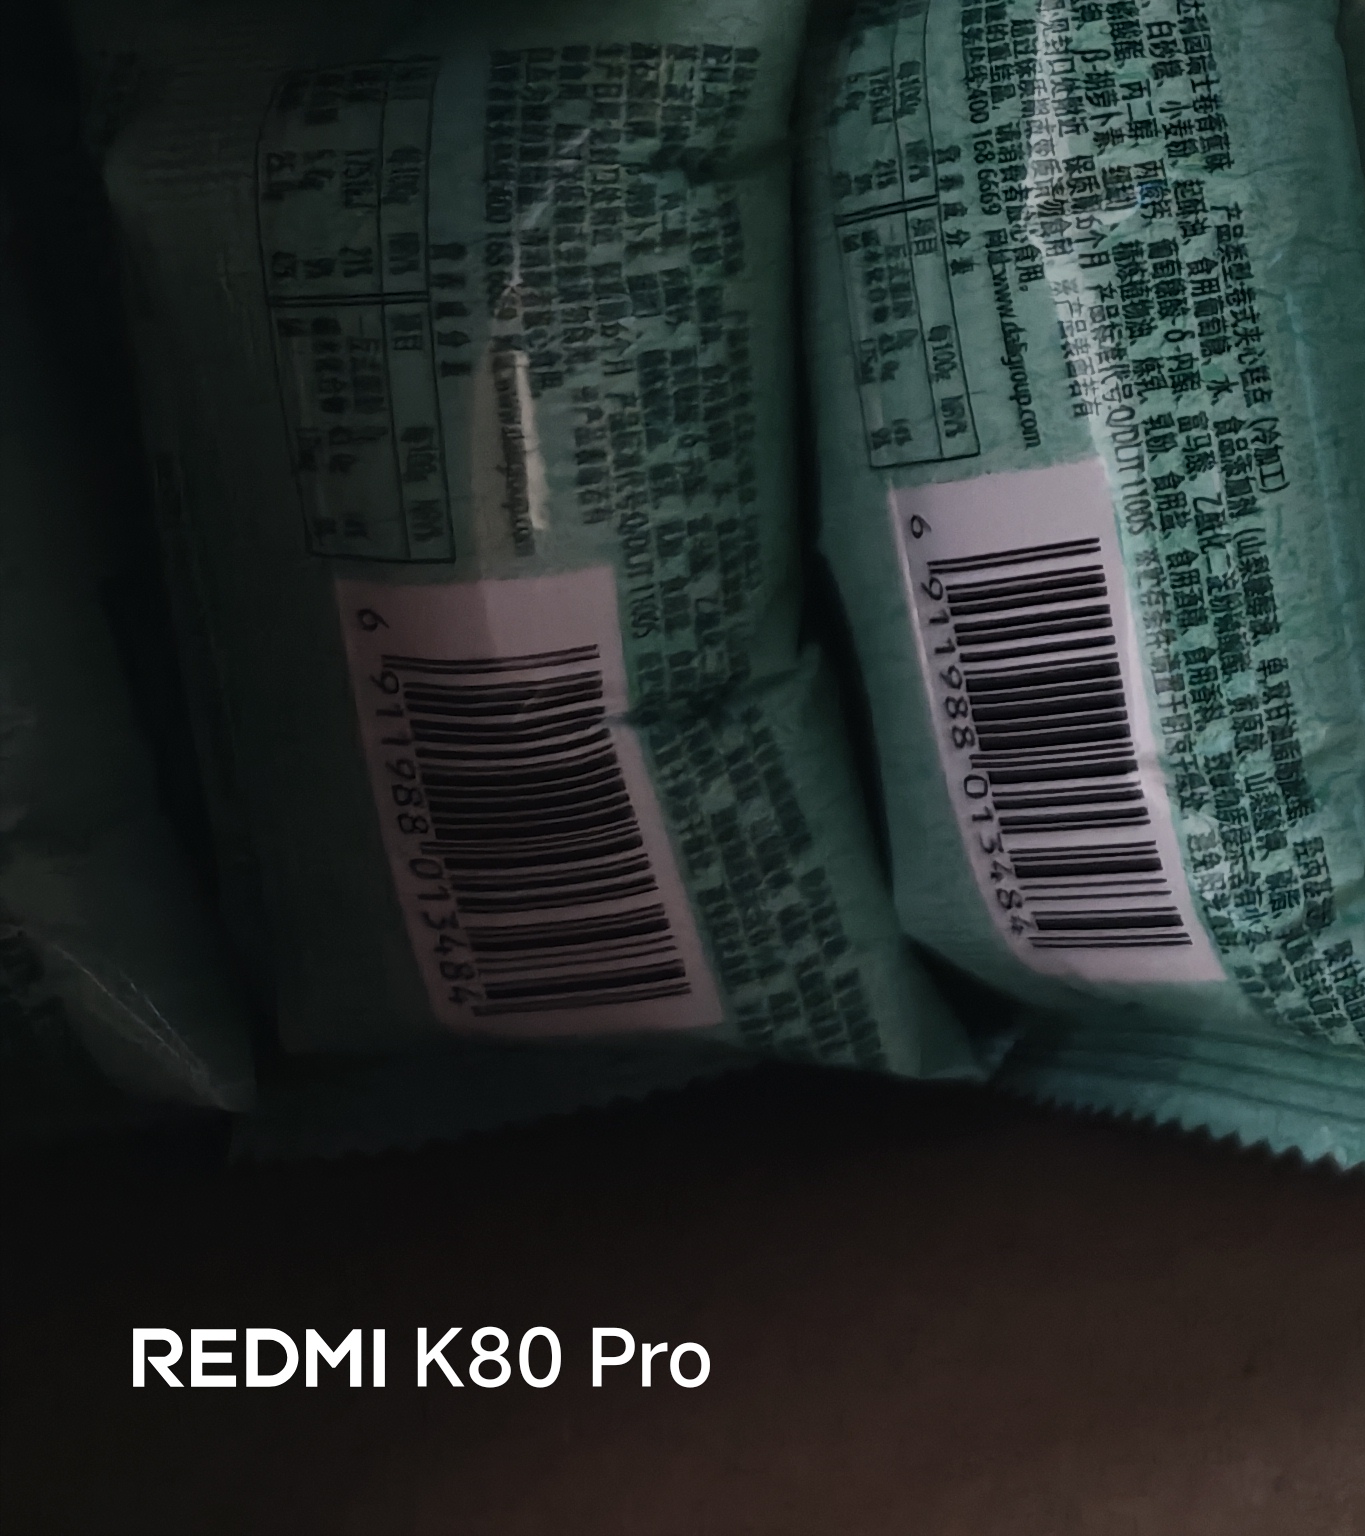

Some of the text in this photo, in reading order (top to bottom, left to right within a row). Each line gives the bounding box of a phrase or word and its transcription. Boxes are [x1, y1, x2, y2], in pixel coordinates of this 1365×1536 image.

[356, 607, 387, 634] 6
[908, 515, 1030, 937] 6 911988 013484
